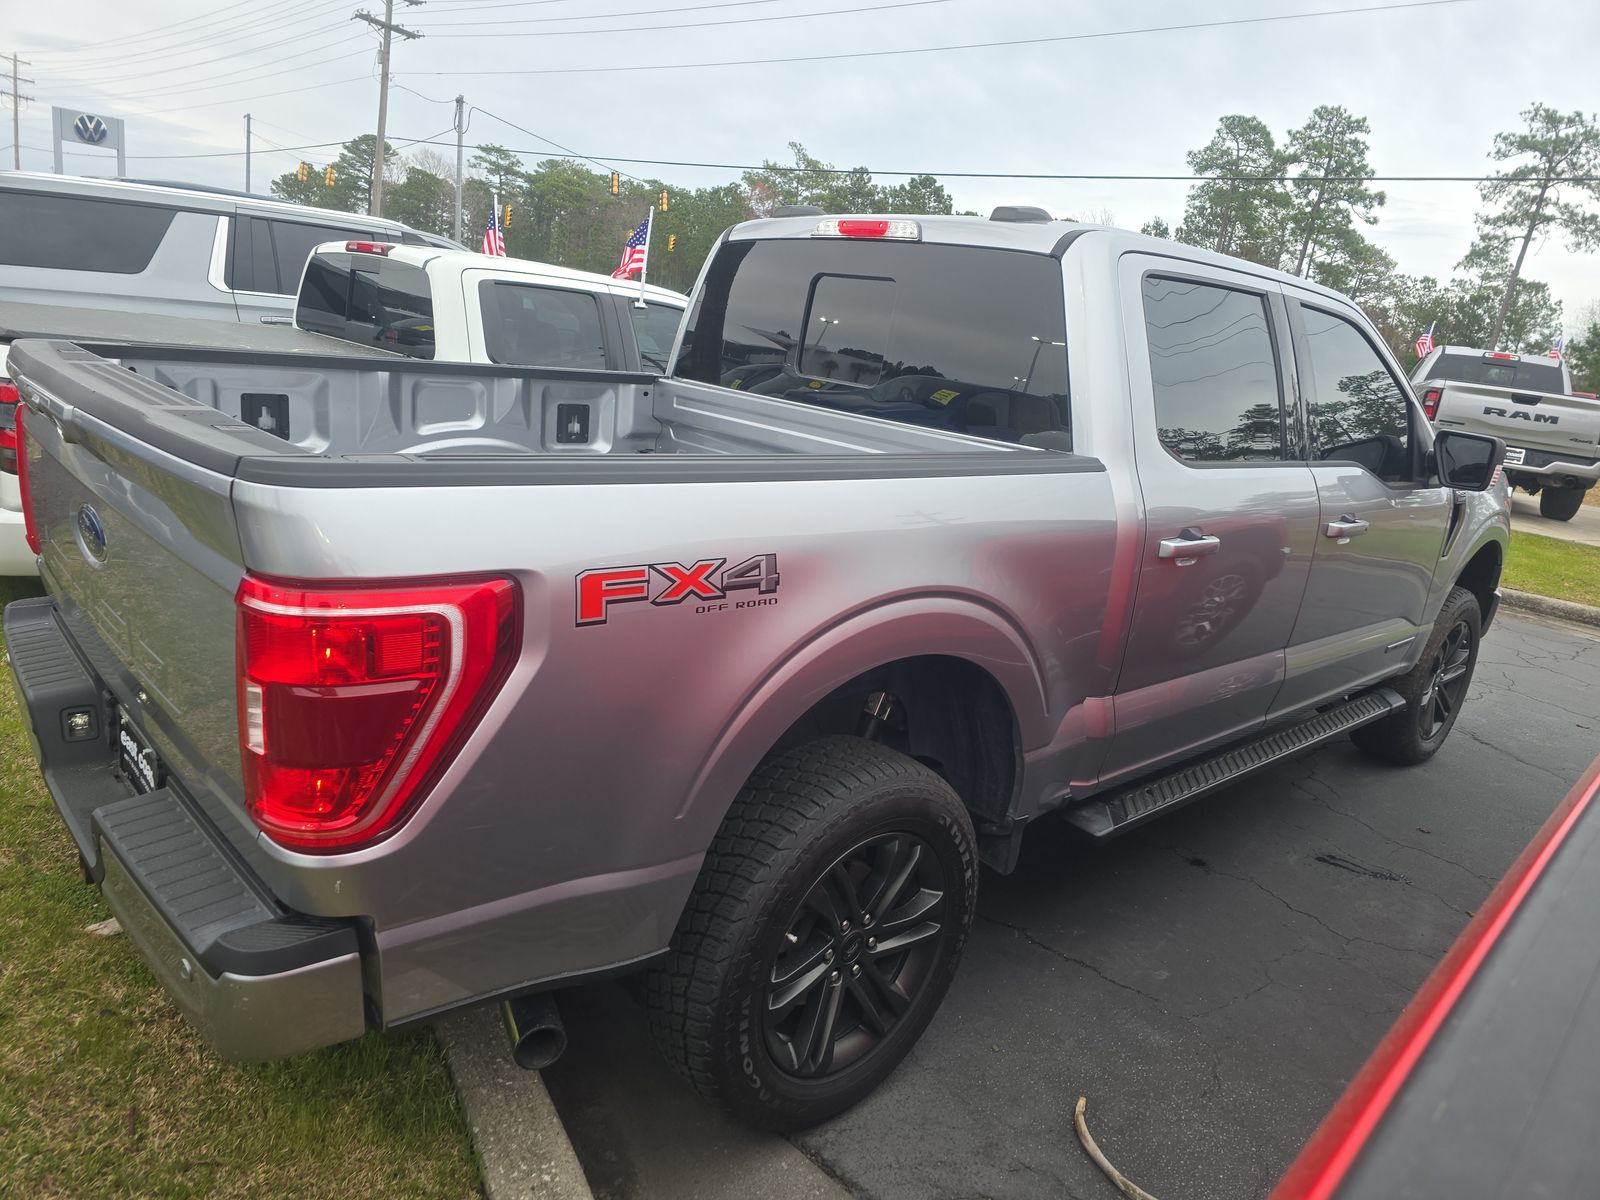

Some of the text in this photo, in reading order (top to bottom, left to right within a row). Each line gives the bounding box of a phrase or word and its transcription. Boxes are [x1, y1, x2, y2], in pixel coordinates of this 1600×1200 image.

[1483, 406, 1559, 425] RAM
[575, 553, 780, 627] FX4
[695, 597, 778, 614] OFF ROAD
